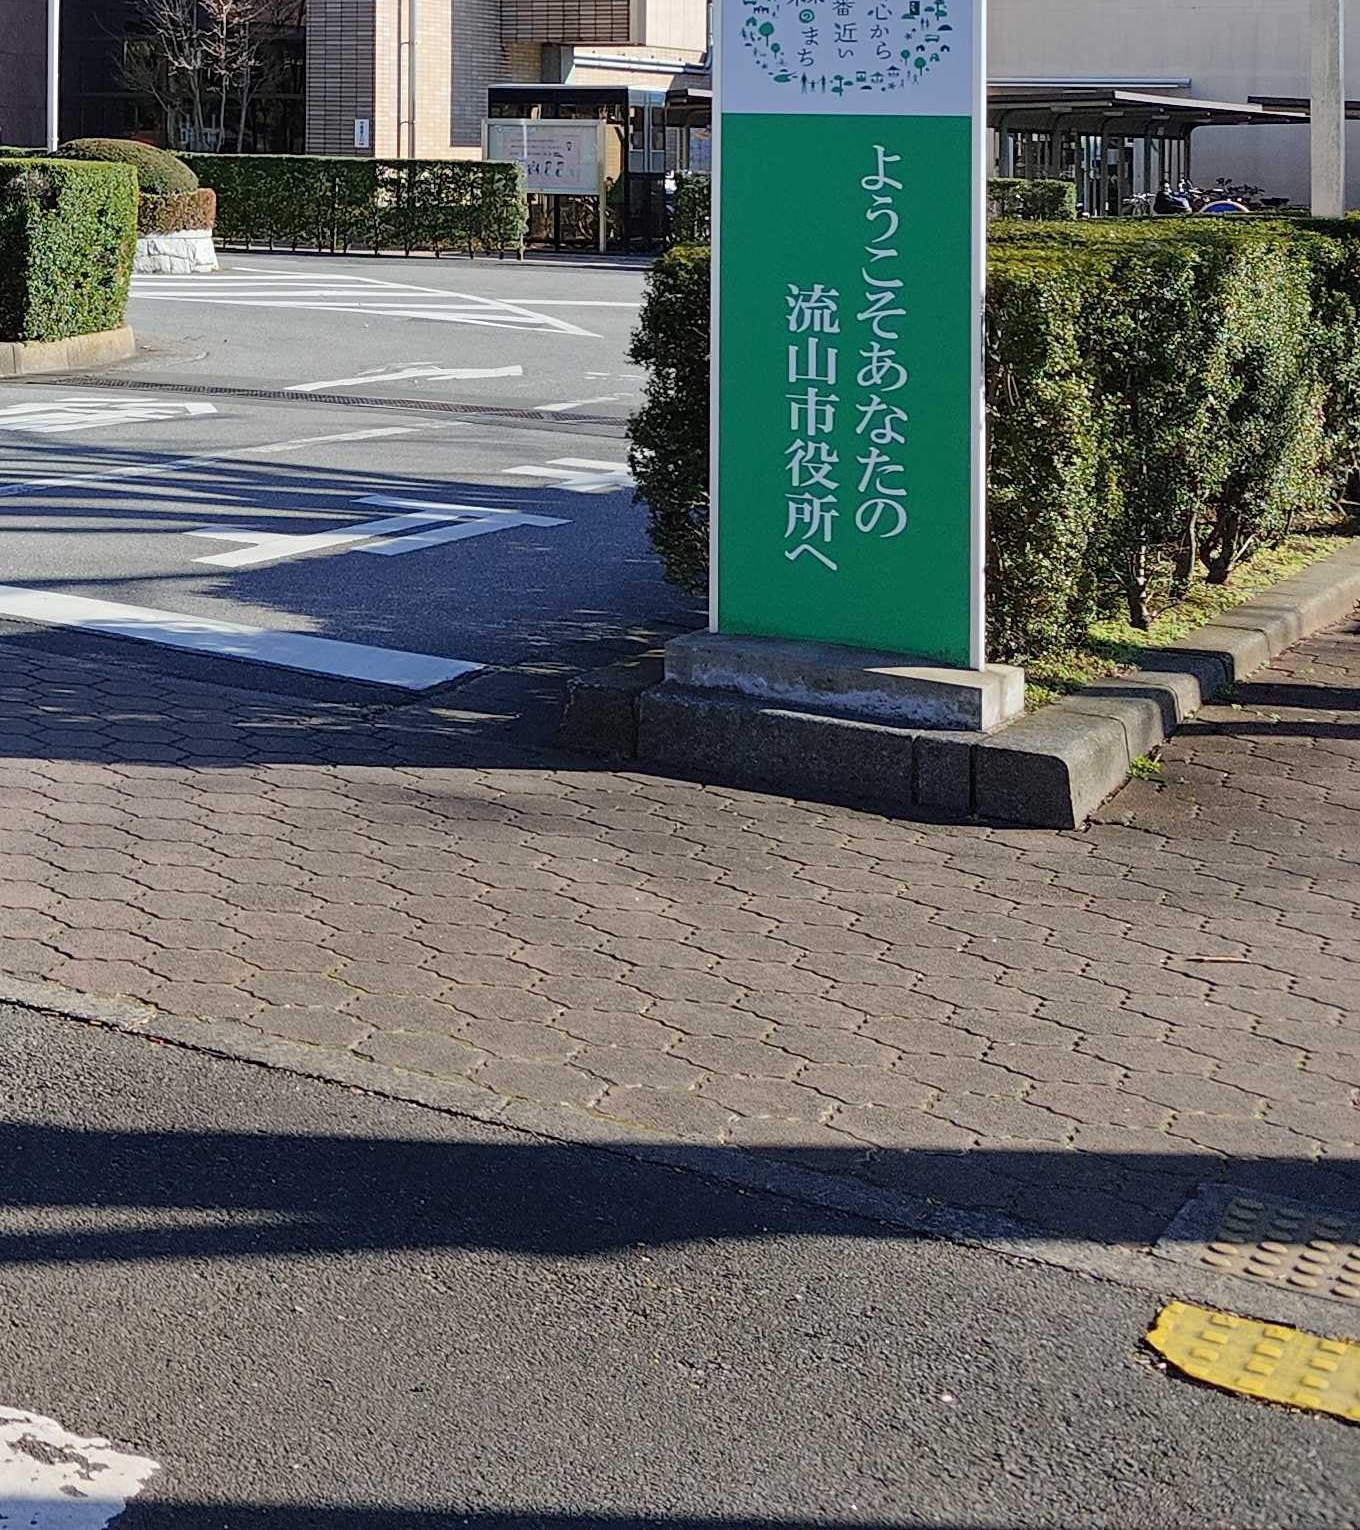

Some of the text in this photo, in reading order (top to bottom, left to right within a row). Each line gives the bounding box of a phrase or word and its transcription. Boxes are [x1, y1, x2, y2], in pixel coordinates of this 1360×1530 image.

[784, 283, 841, 572] 流山市役所へ
[855, 144, 908, 539] ようこそあなたの
